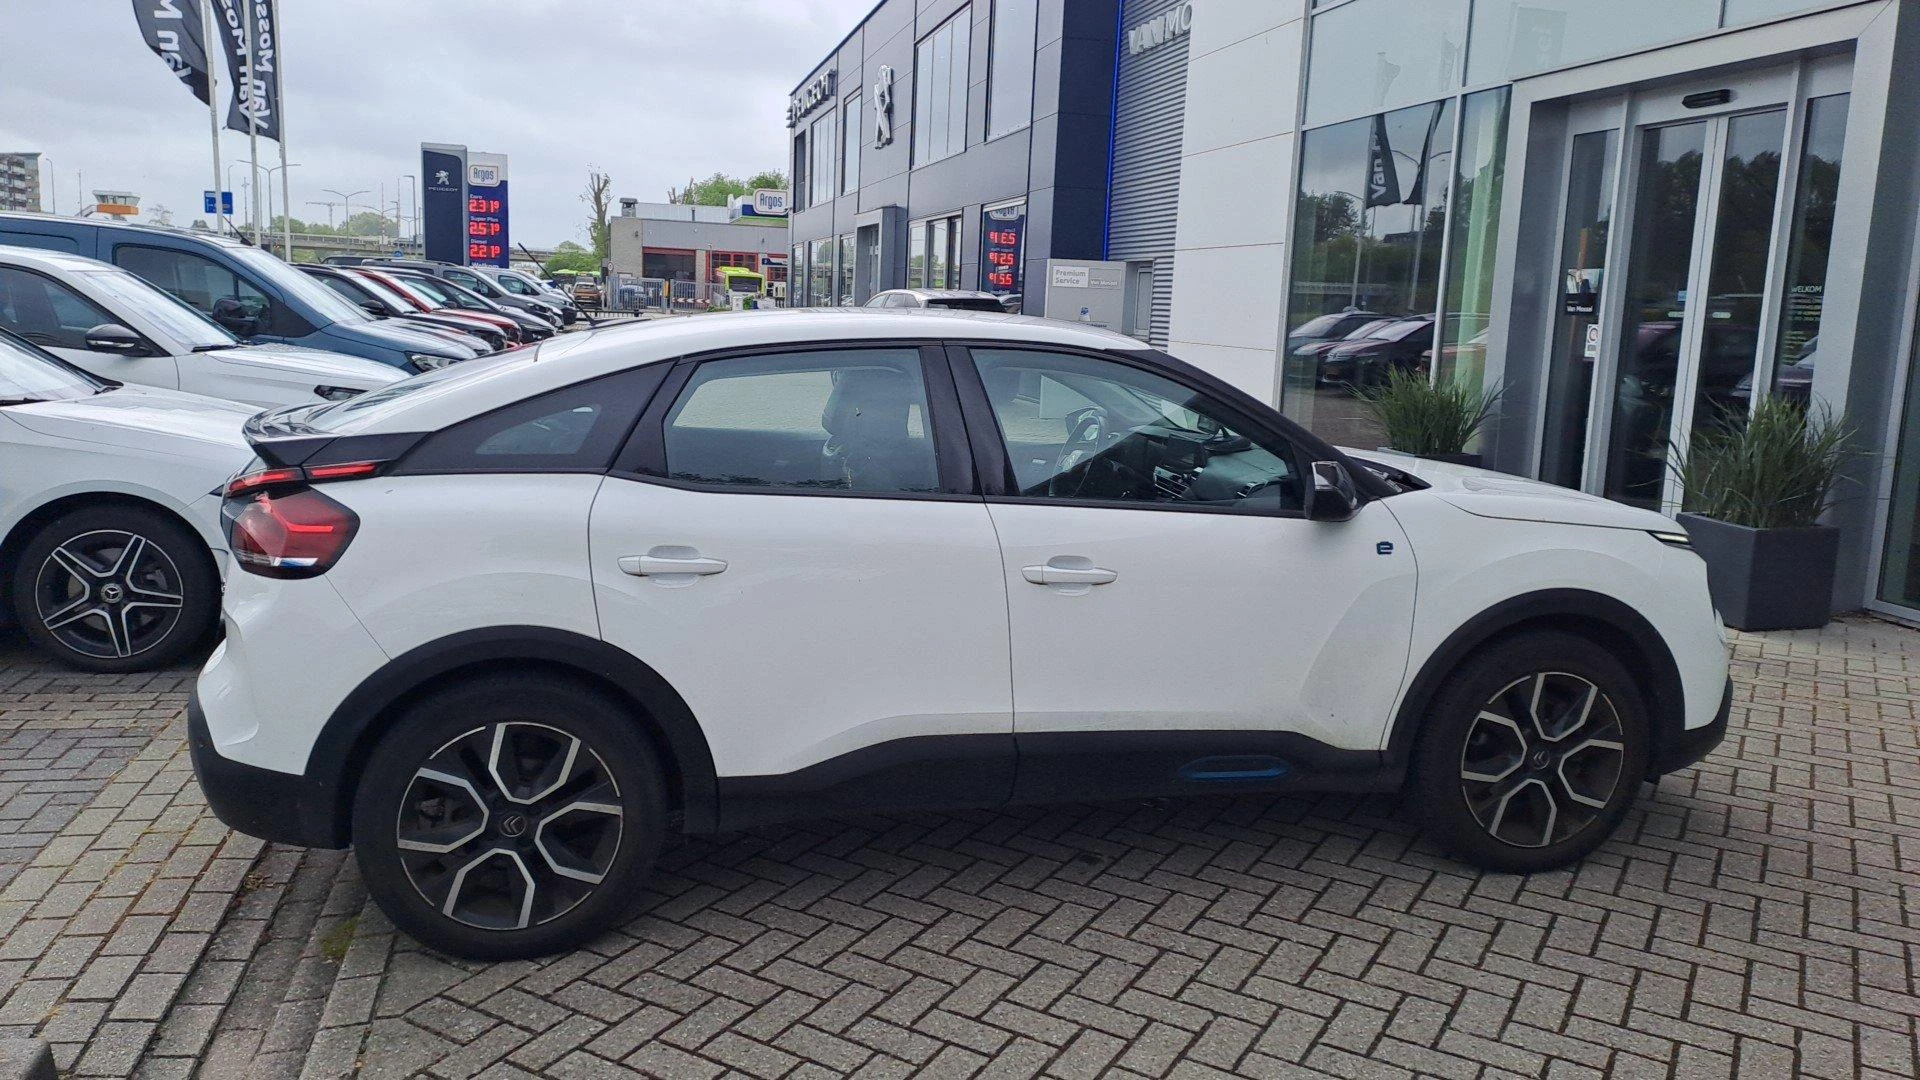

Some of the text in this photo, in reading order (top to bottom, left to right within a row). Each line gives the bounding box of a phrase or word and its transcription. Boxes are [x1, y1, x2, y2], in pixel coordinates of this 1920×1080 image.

[1164, 3, 1192, 40] MO
[474, 167, 494, 182] Argos
[760, 193, 783, 210] Argos
[1056, 269, 1086, 277] Premium
[1055, 277, 1080, 285] Service
[1791, 285, 1822, 293] WELKOM
